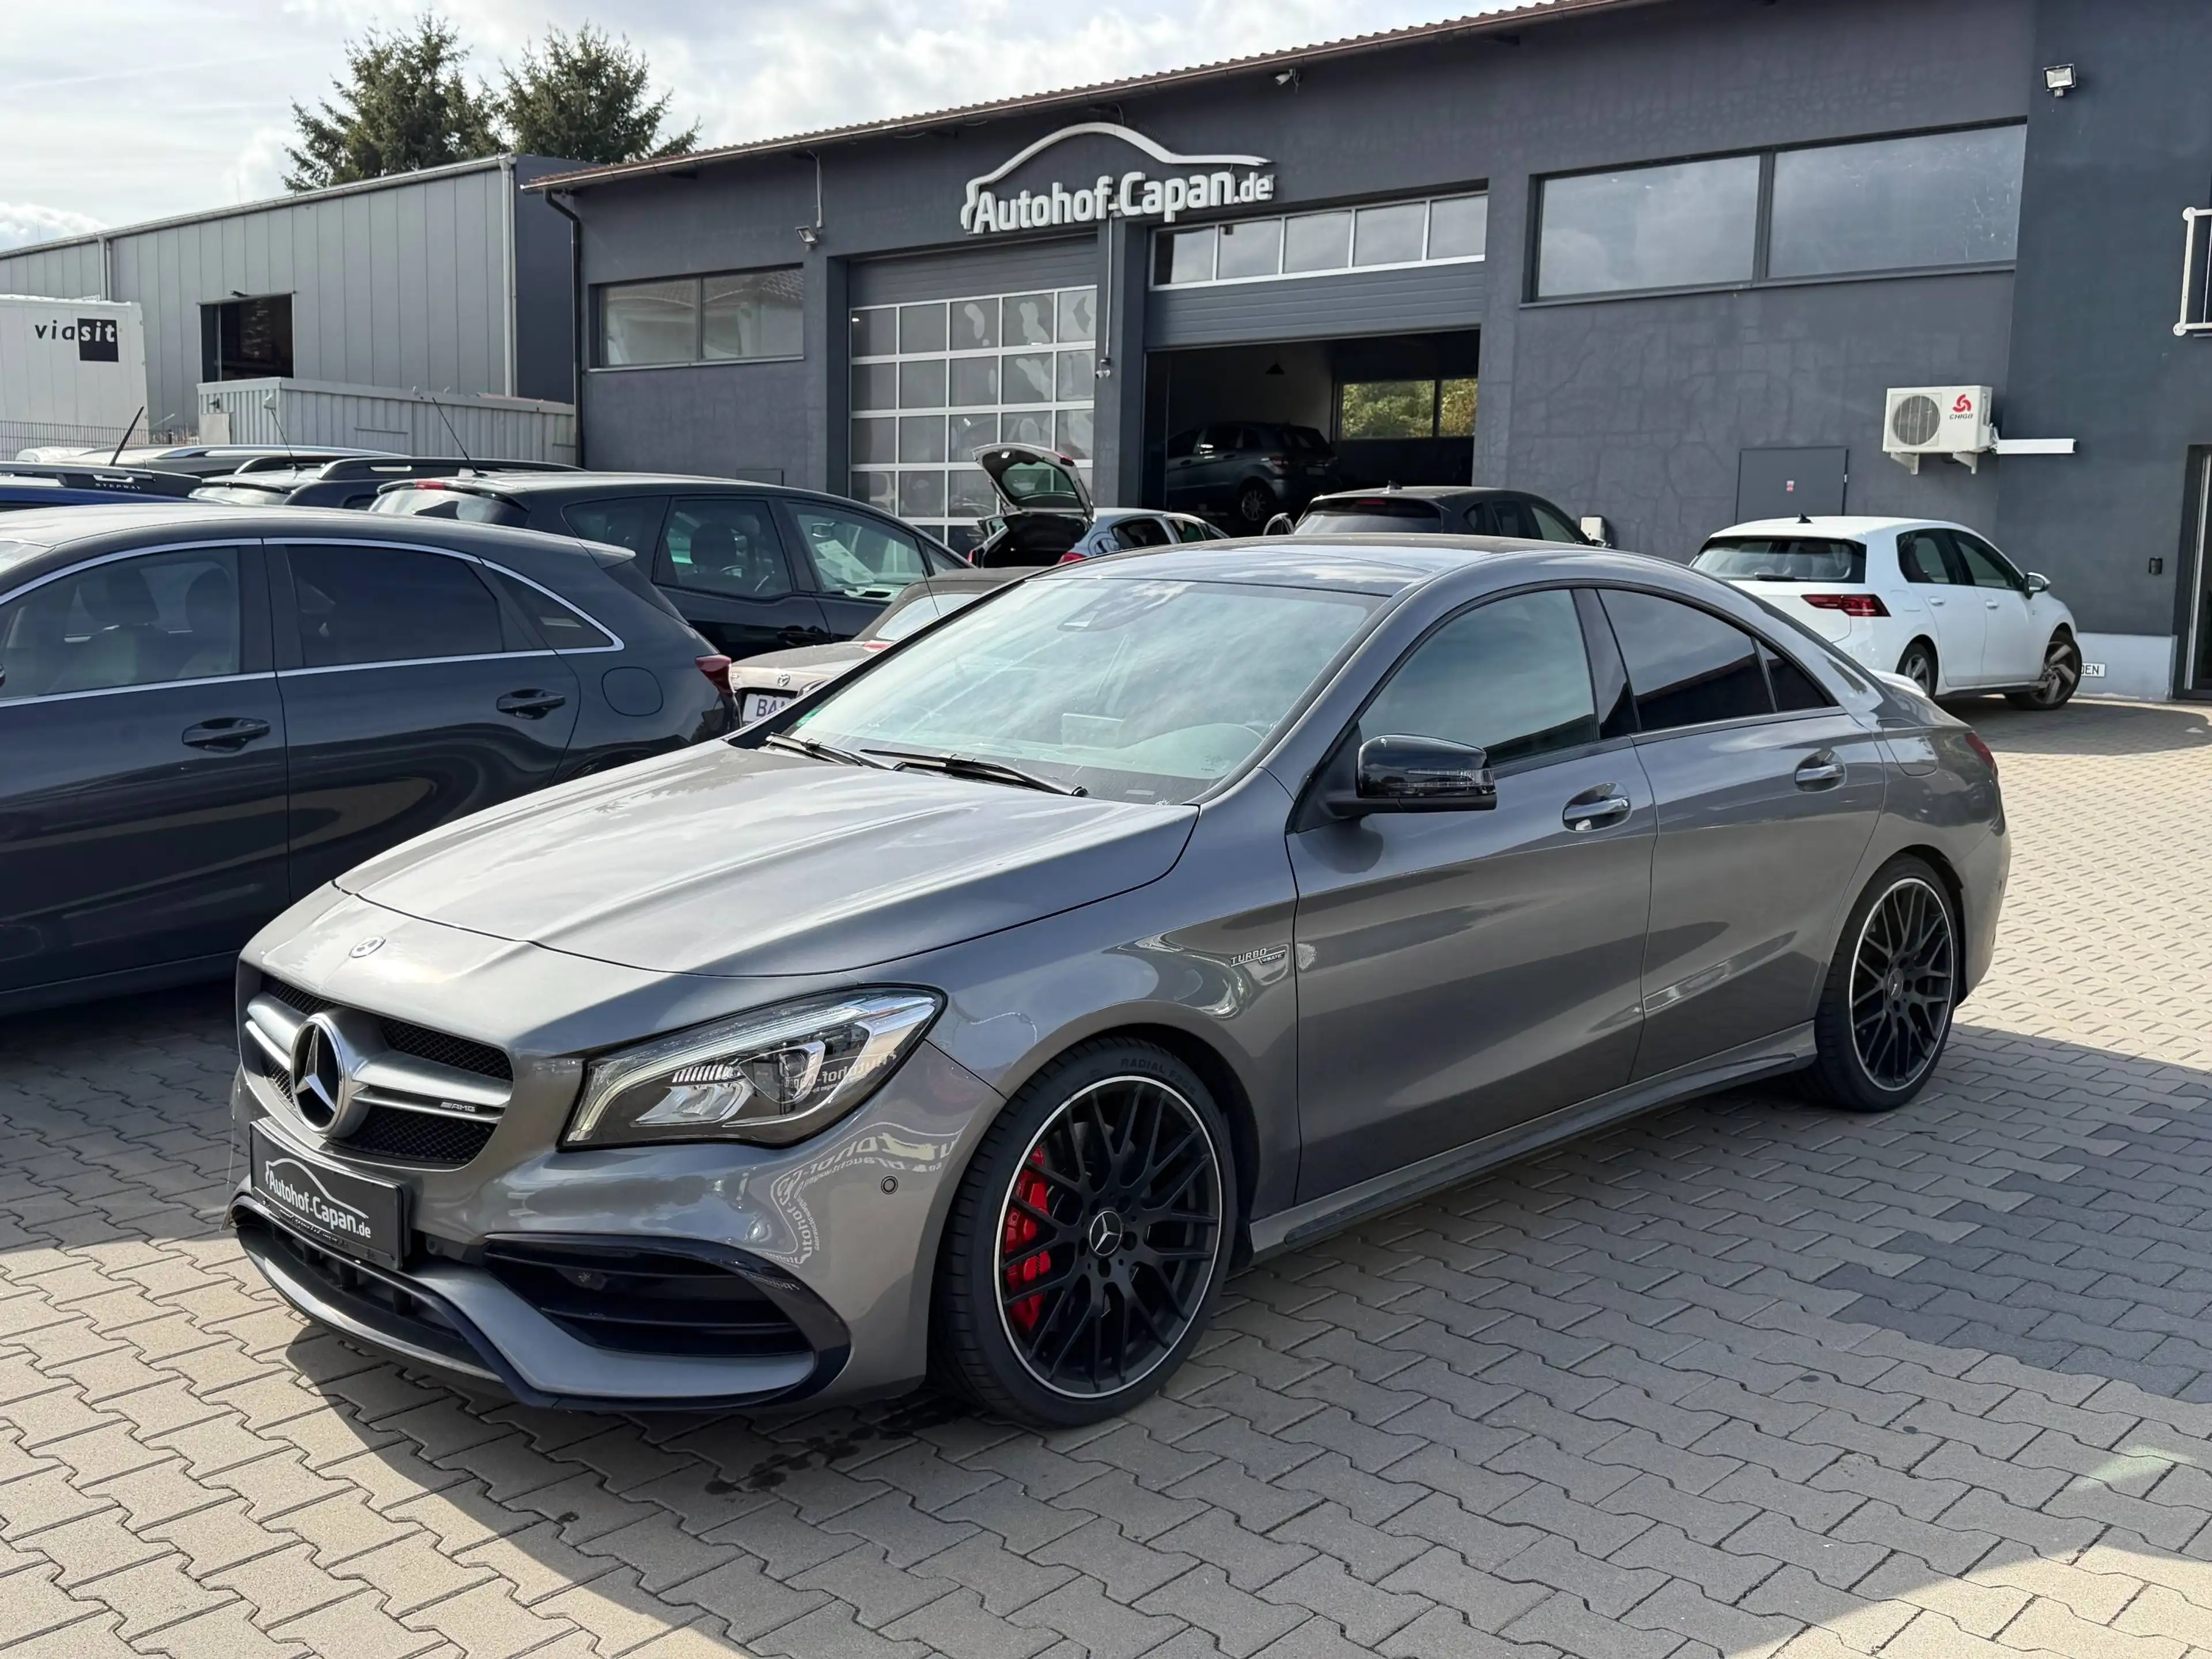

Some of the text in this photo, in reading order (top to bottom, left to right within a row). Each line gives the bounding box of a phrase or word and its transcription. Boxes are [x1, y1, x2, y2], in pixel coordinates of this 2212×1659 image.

[973, 171, 1274, 234] Autohof-Capan.de
[35, 320, 115, 342] viasit
[1230, 948, 1267, 965] TURBO
[1121, 1058, 1164, 1074] RADIAL
[451, 1103, 476, 1112] AMG
[269, 1169, 371, 1238] Autohof-Capan.de
